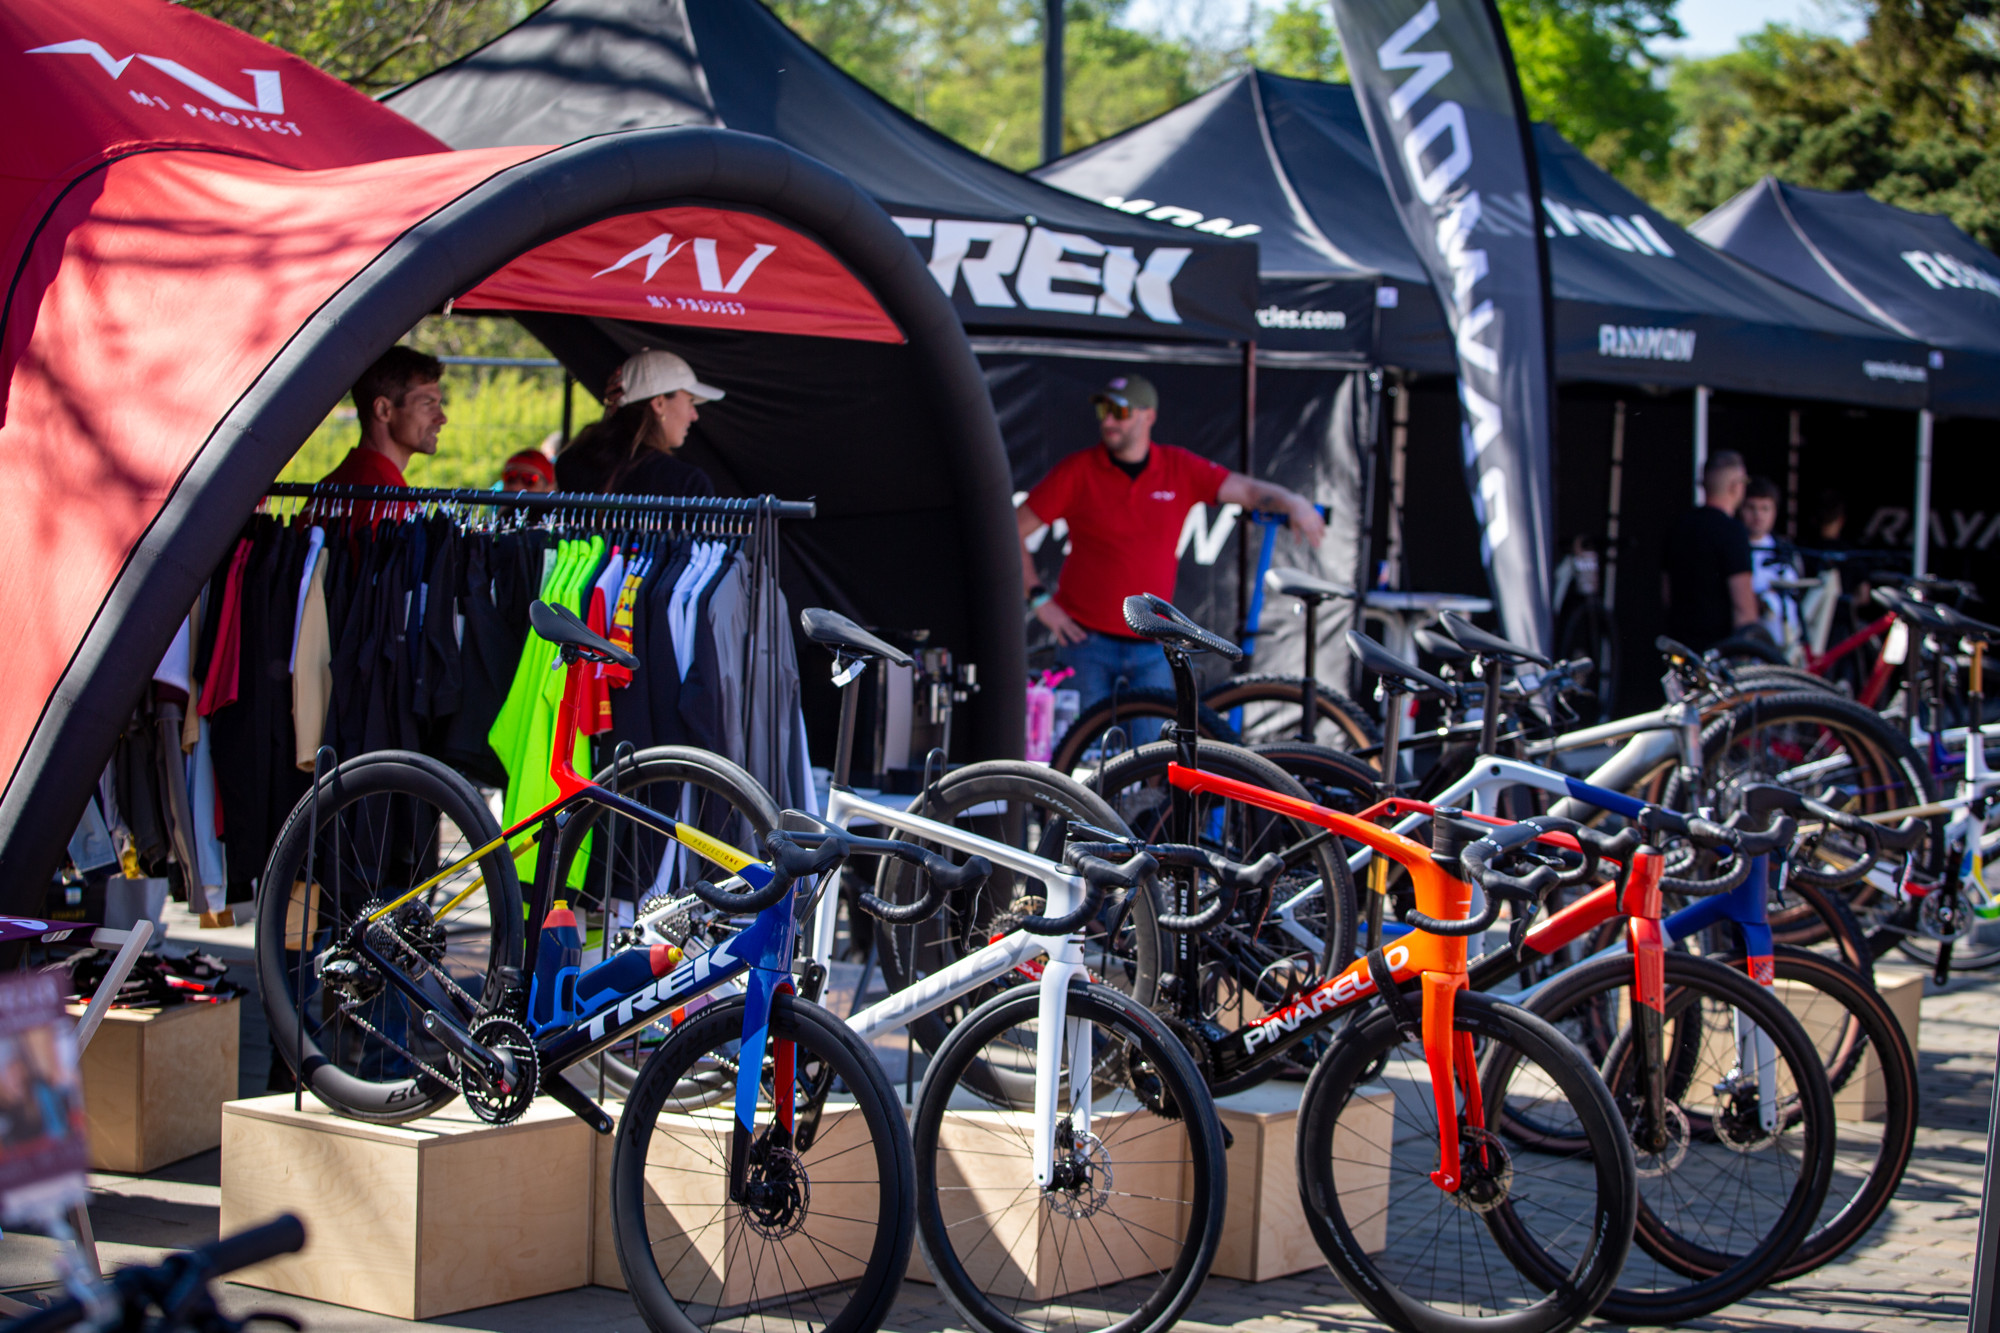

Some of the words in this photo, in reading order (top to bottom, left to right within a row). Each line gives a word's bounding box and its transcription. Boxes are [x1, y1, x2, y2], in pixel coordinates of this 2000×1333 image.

[182, 103, 302, 137] PROJECT
[676, 298, 746, 316] PROJECT
[1255, 305, 1346, 330] cles.com
[1598, 324, 1697, 362] RAYMON
[692, 838, 739, 866] PROJECTONE
[577, 935, 740, 1042] TREK
[866, 932, 1031, 1033] RIDLEY
[1243, 945, 1410, 1055] PINARELO
[676, 1007, 712, 1035] PIRELLI
